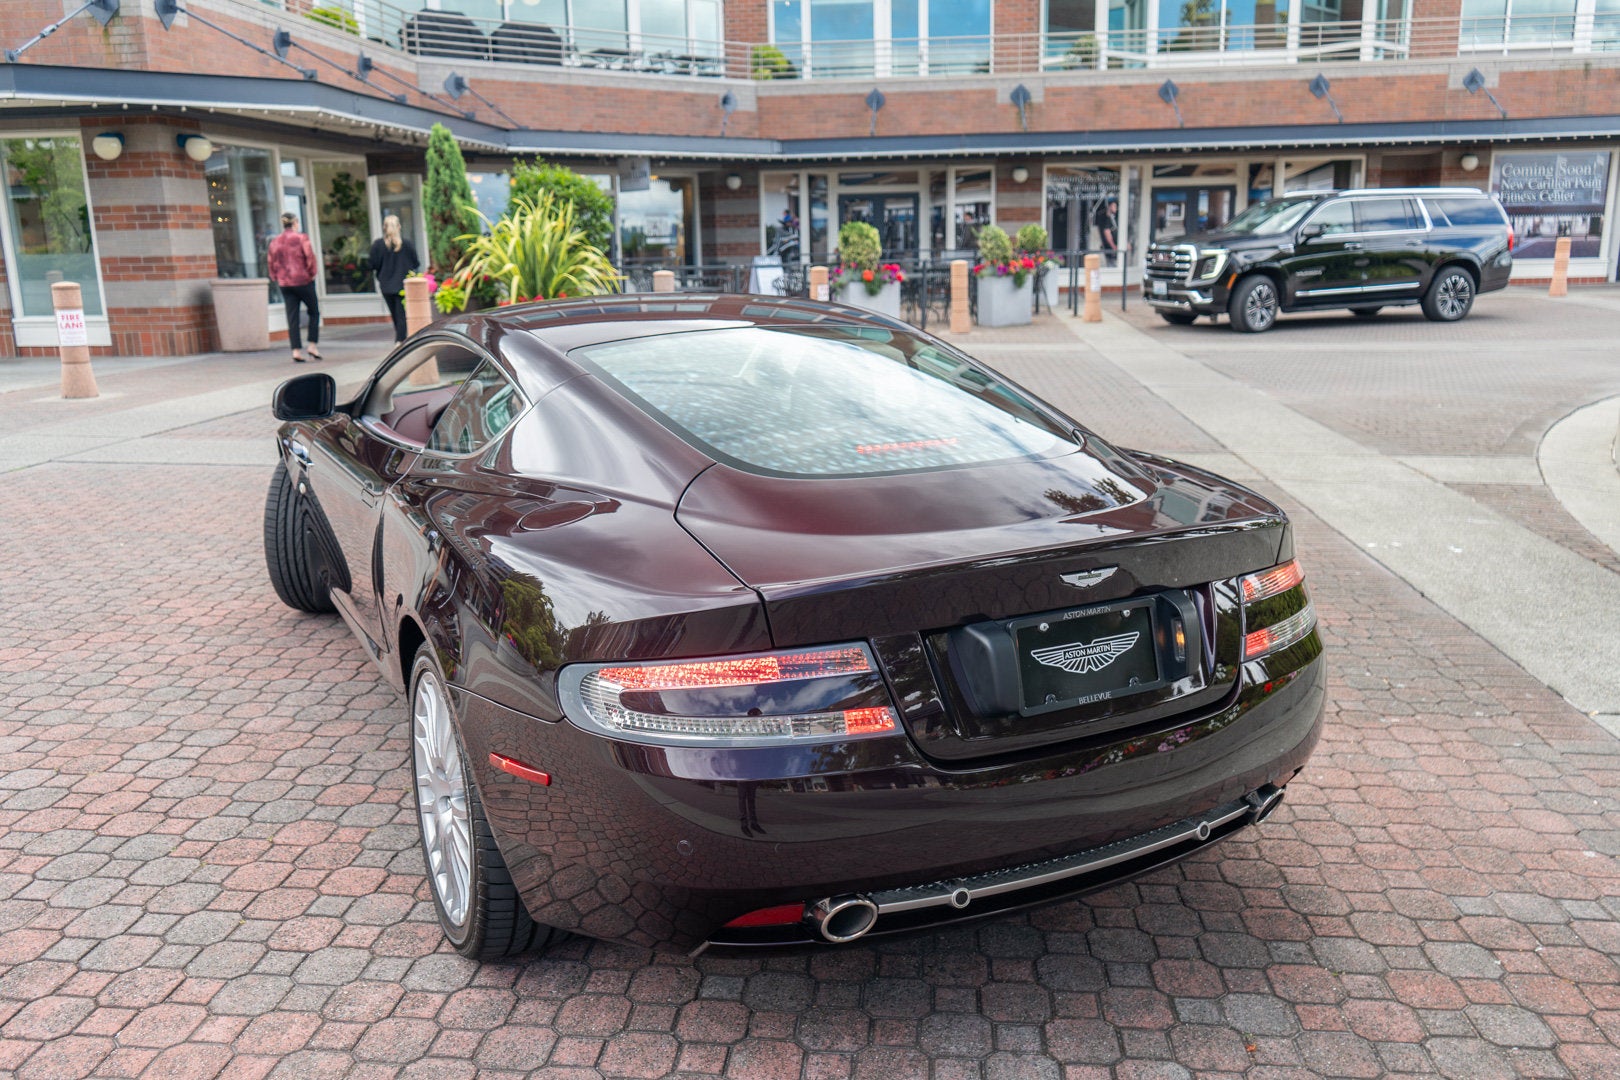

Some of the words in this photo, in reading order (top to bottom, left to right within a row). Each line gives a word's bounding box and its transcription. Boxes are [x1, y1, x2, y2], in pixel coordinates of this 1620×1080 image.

[1502, 162, 1554, 179] Coming
[1560, 162, 1598, 176] Soon!
[1502, 179, 1525, 191] New
[1528, 178, 1571, 190] Carillon
[1576, 177, 1602, 189] Point
[1500, 191, 1537, 202] Fitness
[1540, 190, 1575, 202] Center
[1063, 610, 1086, 620] ASTON
[1087, 606, 1111, 615] MARTIN
[1065, 649, 1086, 660] ASTON
[1086, 645, 1111, 655] MARTIN
[1079, 691, 1112, 705] BELLEVUE
